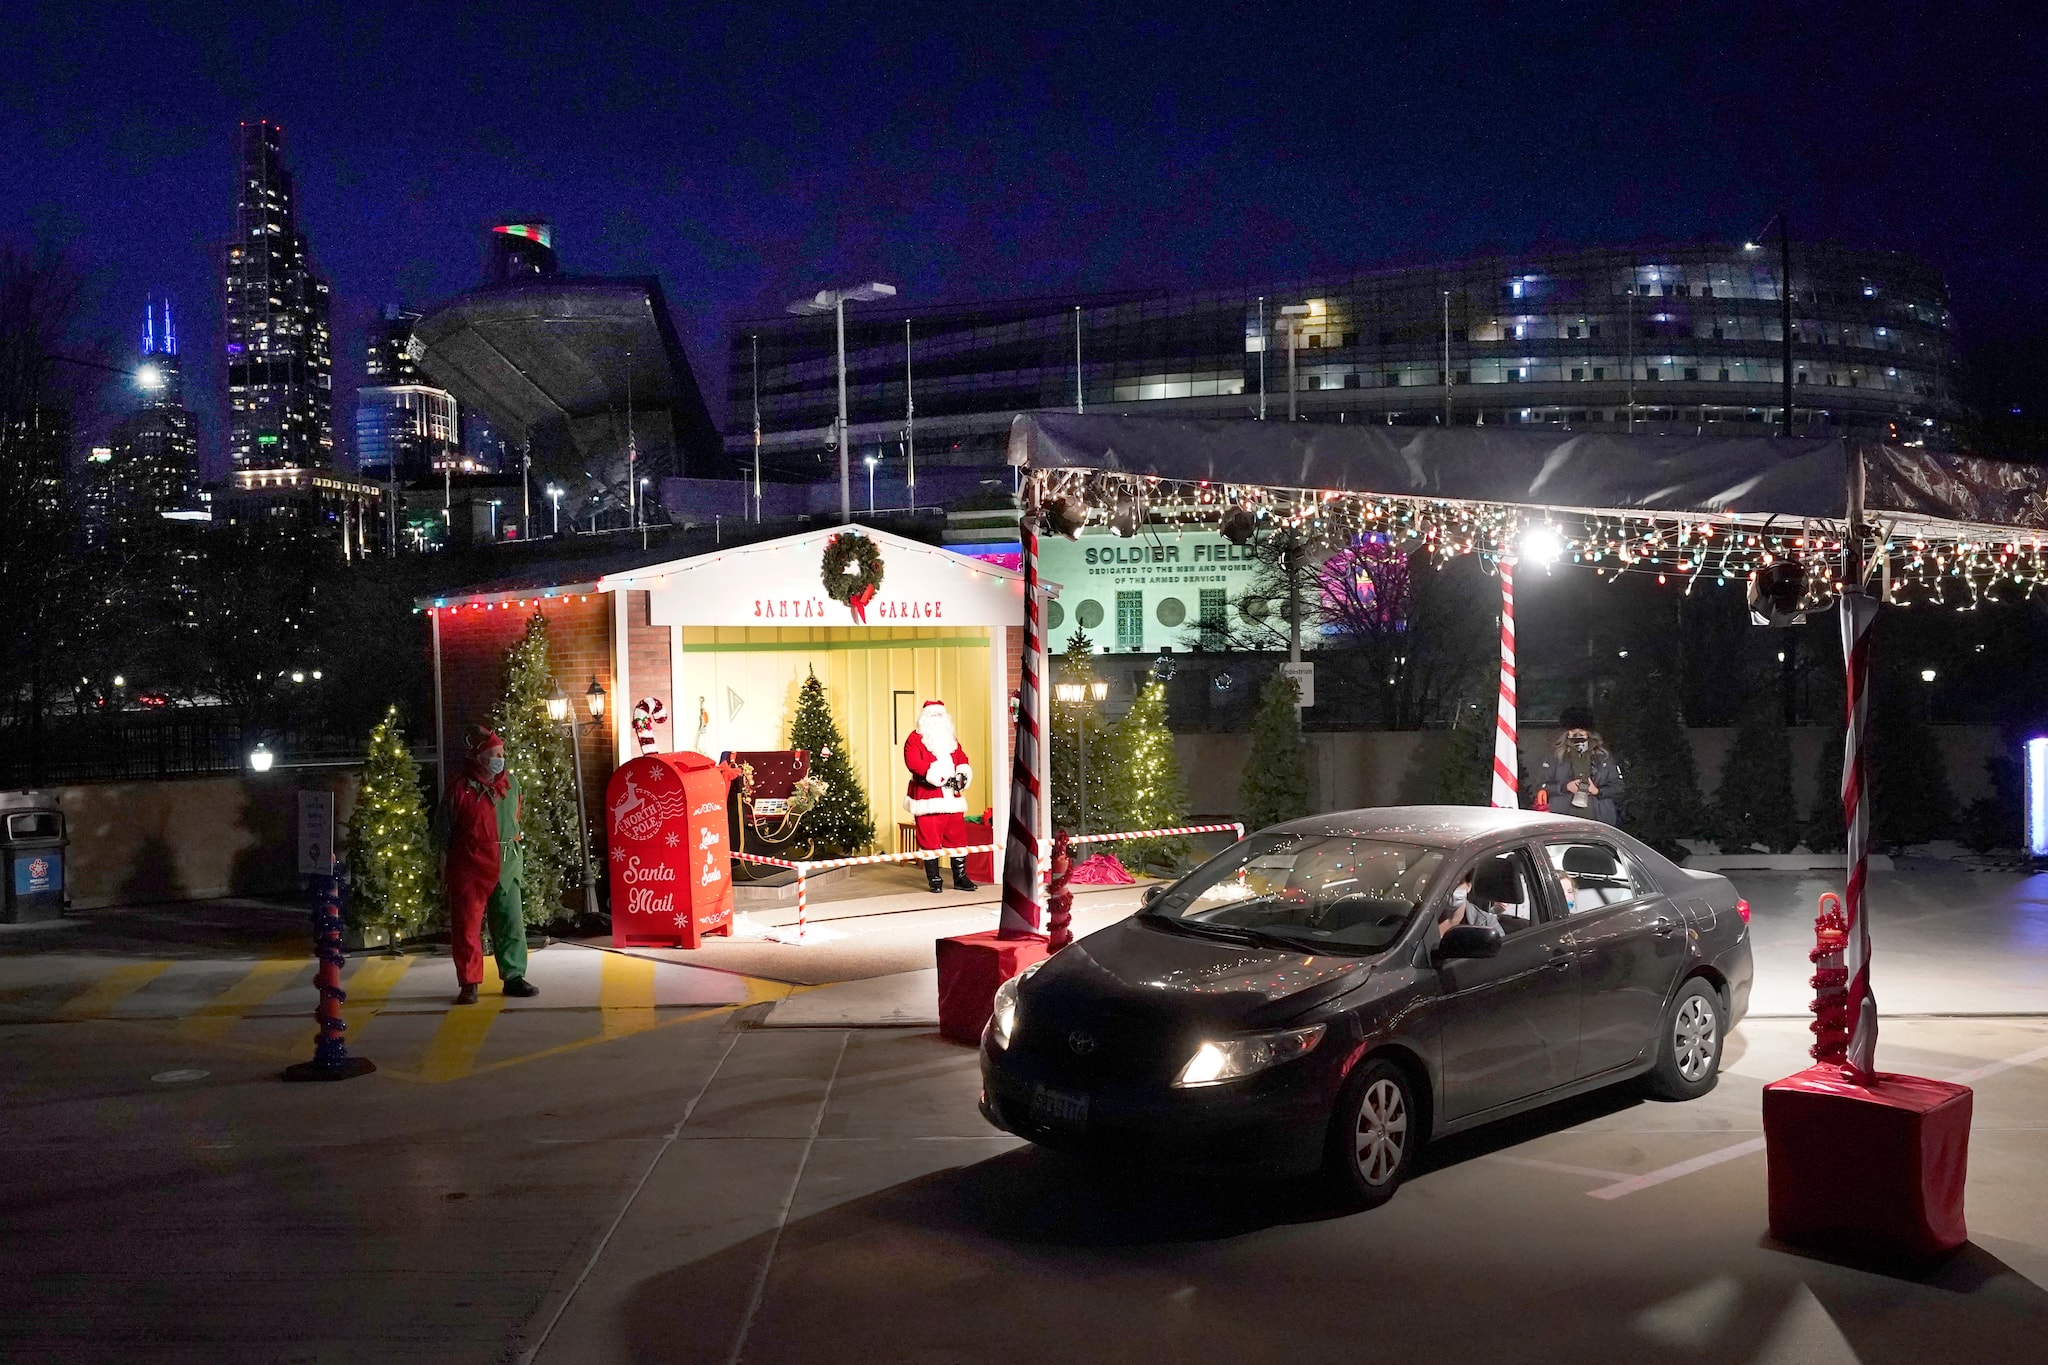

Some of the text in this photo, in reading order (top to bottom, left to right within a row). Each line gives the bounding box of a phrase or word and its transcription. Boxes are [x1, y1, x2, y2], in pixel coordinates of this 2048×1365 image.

[1085, 544, 1256, 565] SOLDIER FIELD
[1088, 566, 1138, 575] DEDICATED
[1142, 566, 1153, 574] TO
[1176, 565, 1195, 573] MEN
[1220, 564, 1253, 572] WOMEN
[1150, 576, 1180, 584] ARMED
[1183, 575, 1227, 583] SERVICES
[754, 596, 942, 618] SANTA'S GARAGE
[623, 804, 657, 830] NORTH
[633, 818, 657, 836] POLE
[706, 850, 713, 864] to
[623, 856, 676, 885] Santa
[701, 865, 722, 886] Santa
[628, 887, 674, 914] Mail
